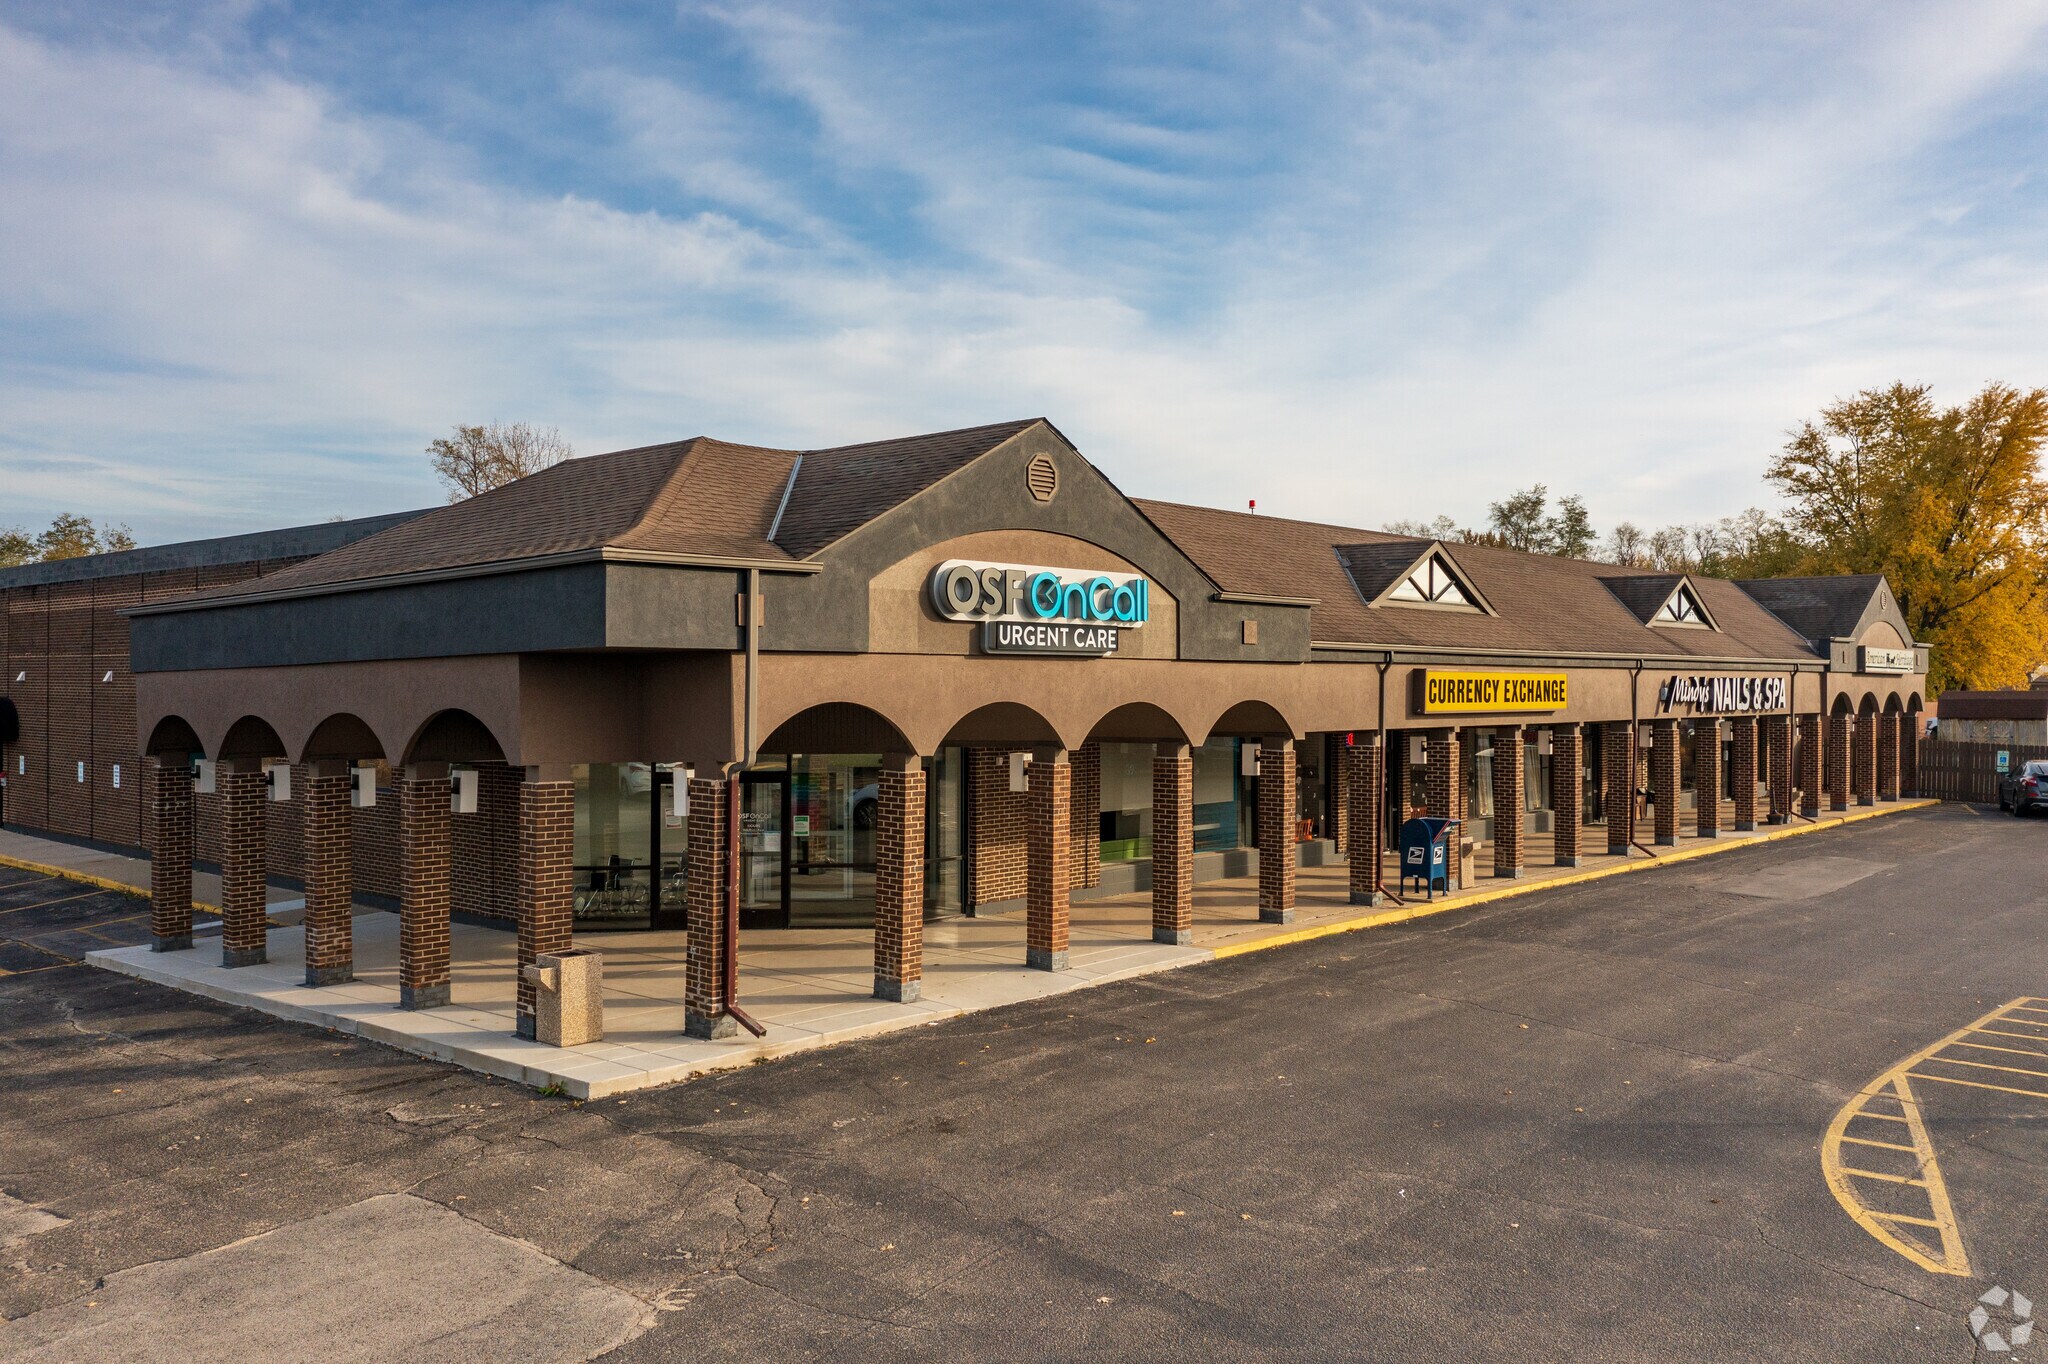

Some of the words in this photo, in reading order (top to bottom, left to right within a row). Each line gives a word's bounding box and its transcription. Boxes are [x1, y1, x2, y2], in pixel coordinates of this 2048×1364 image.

[946, 565, 1026, 615] OSF
[1029, 571, 1149, 622] OnCall
[1000, 625, 1069, 646] URGENT
[1074, 628, 1117, 648] CARE
[1428, 678, 1500, 704] CURRENCY
[1504, 679, 1566, 703] EXCHANGE
[1668, 676, 1710, 713] Mindy's
[1713, 677, 1751, 712] NAILS
[1753, 678, 1763, 710] &
[1764, 678, 1787, 709] SPA
